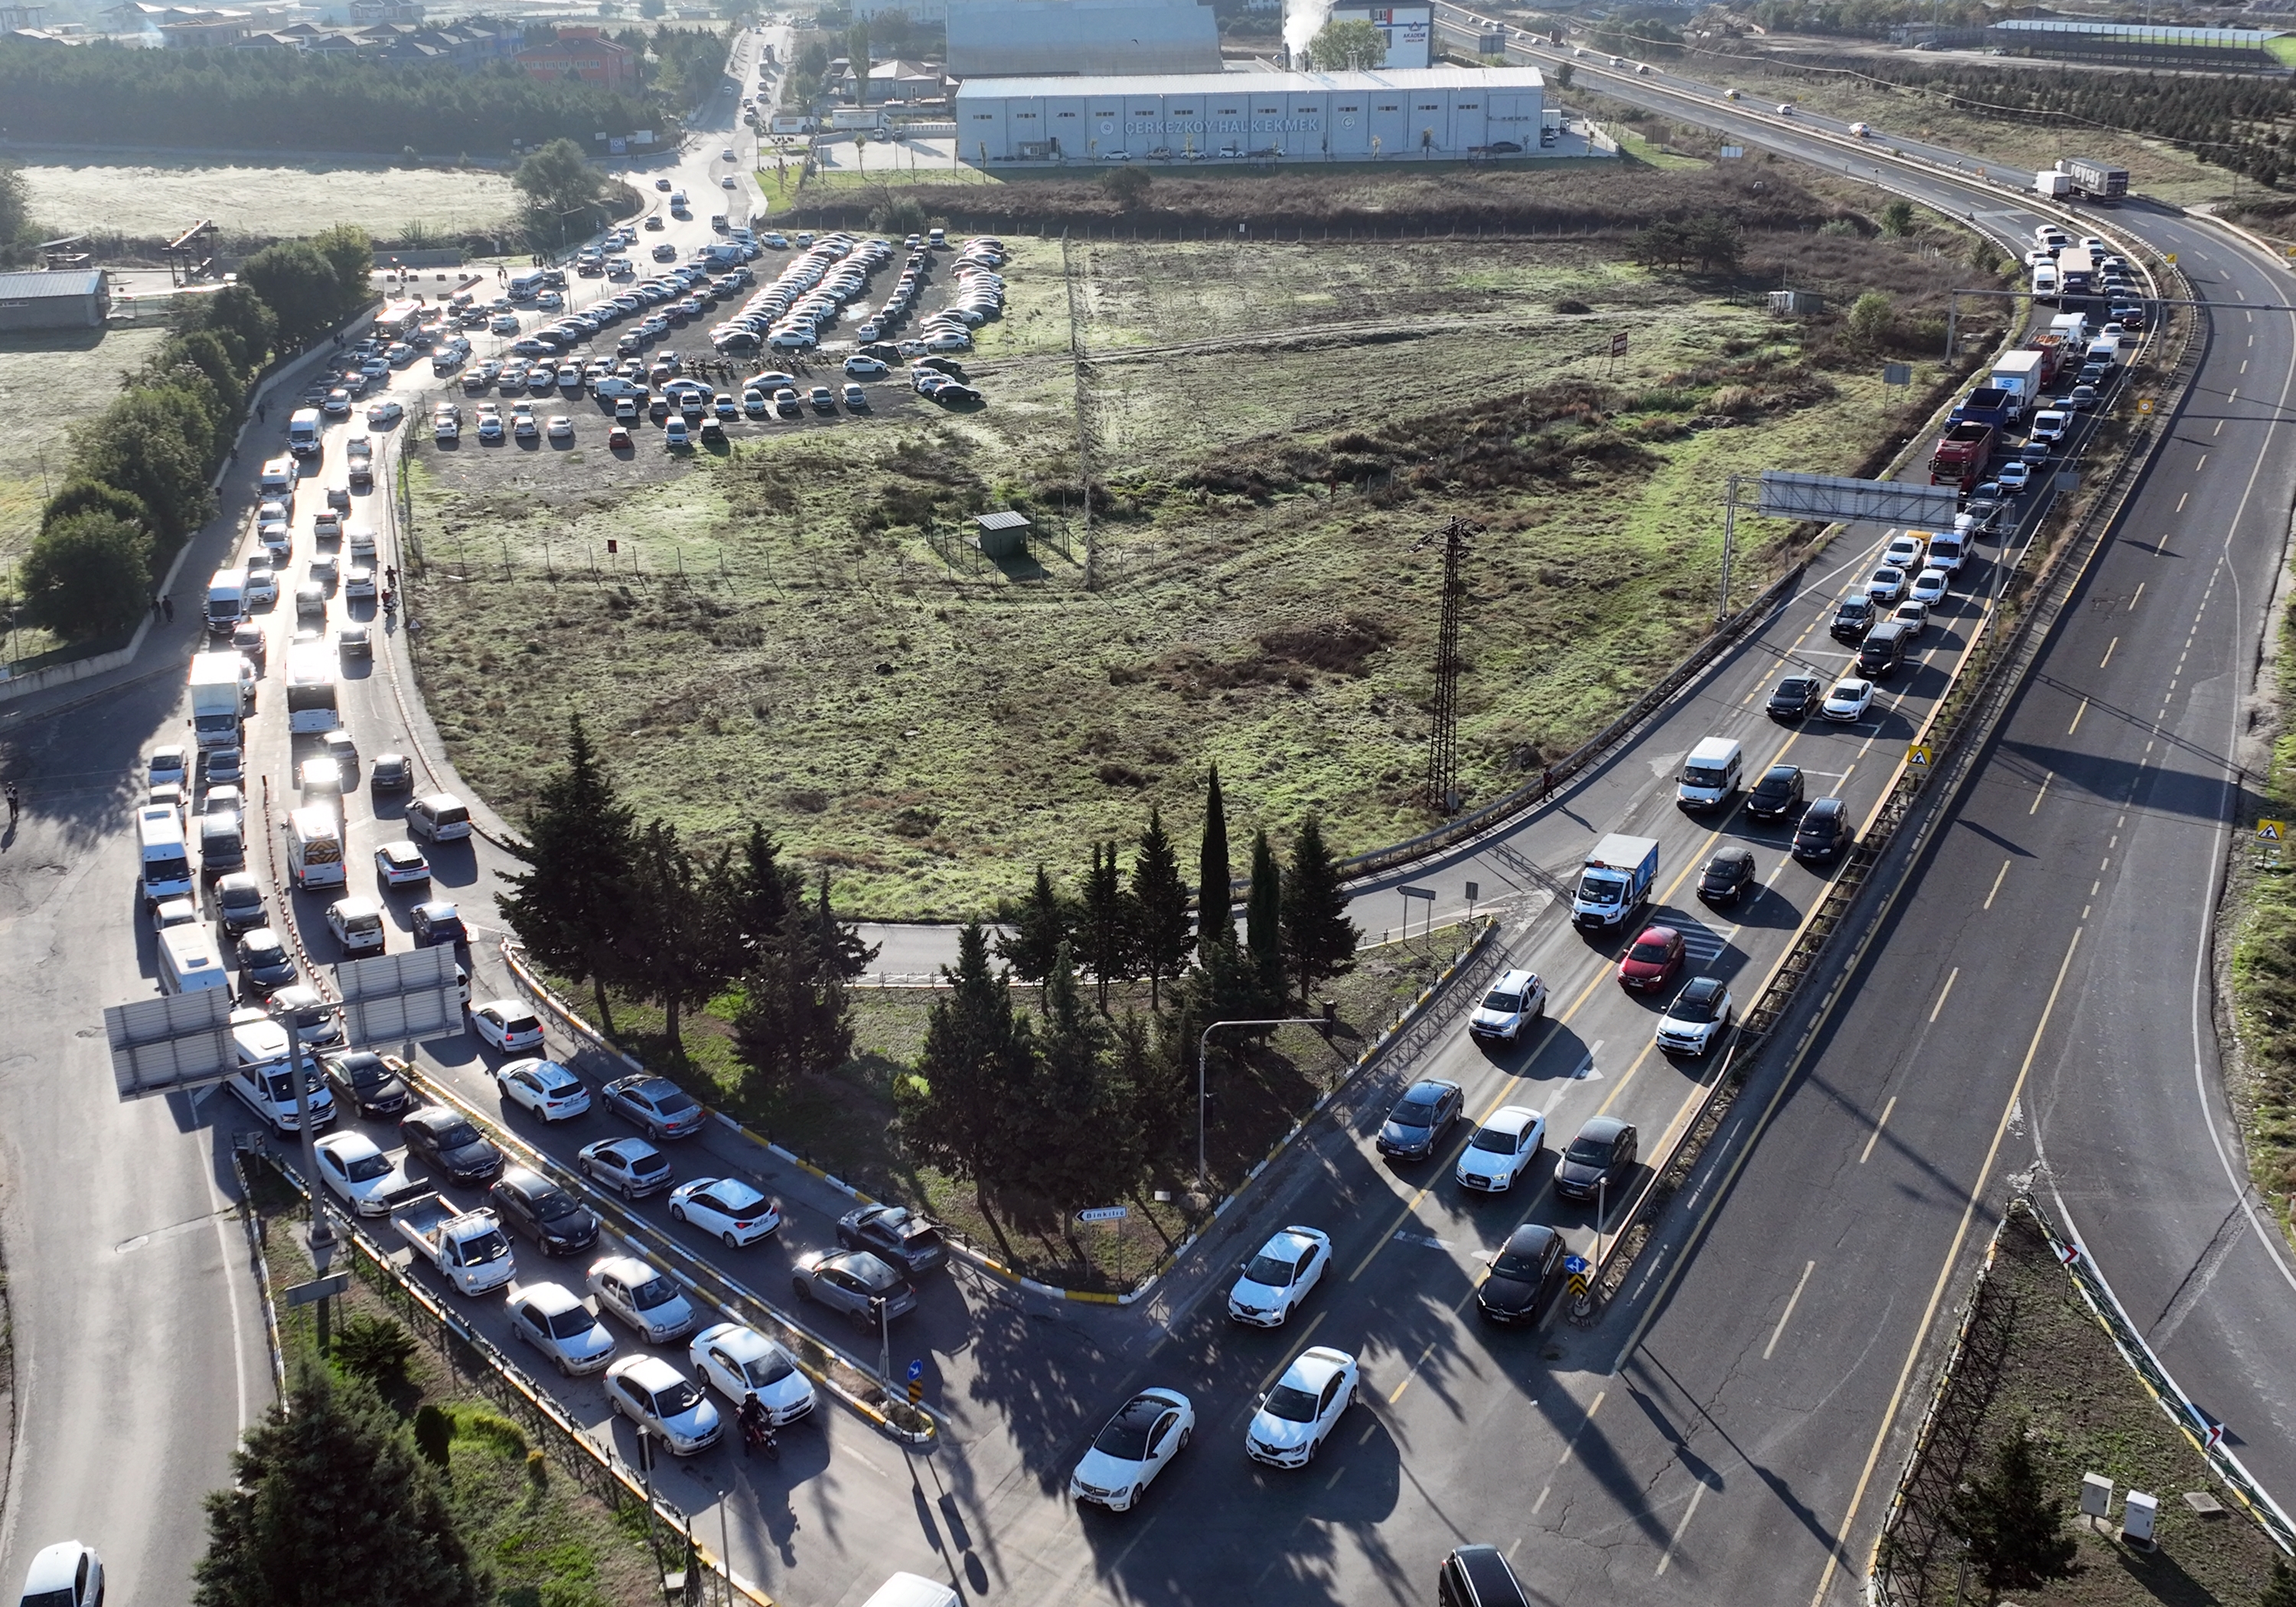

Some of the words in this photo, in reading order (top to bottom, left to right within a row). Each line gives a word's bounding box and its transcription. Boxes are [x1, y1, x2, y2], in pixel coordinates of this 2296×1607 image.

[1124, 119, 1213, 136] ÇERKEZKÖY
[1218, 120, 1261, 132] HALK
[1265, 119, 1319, 132] EKMEK
